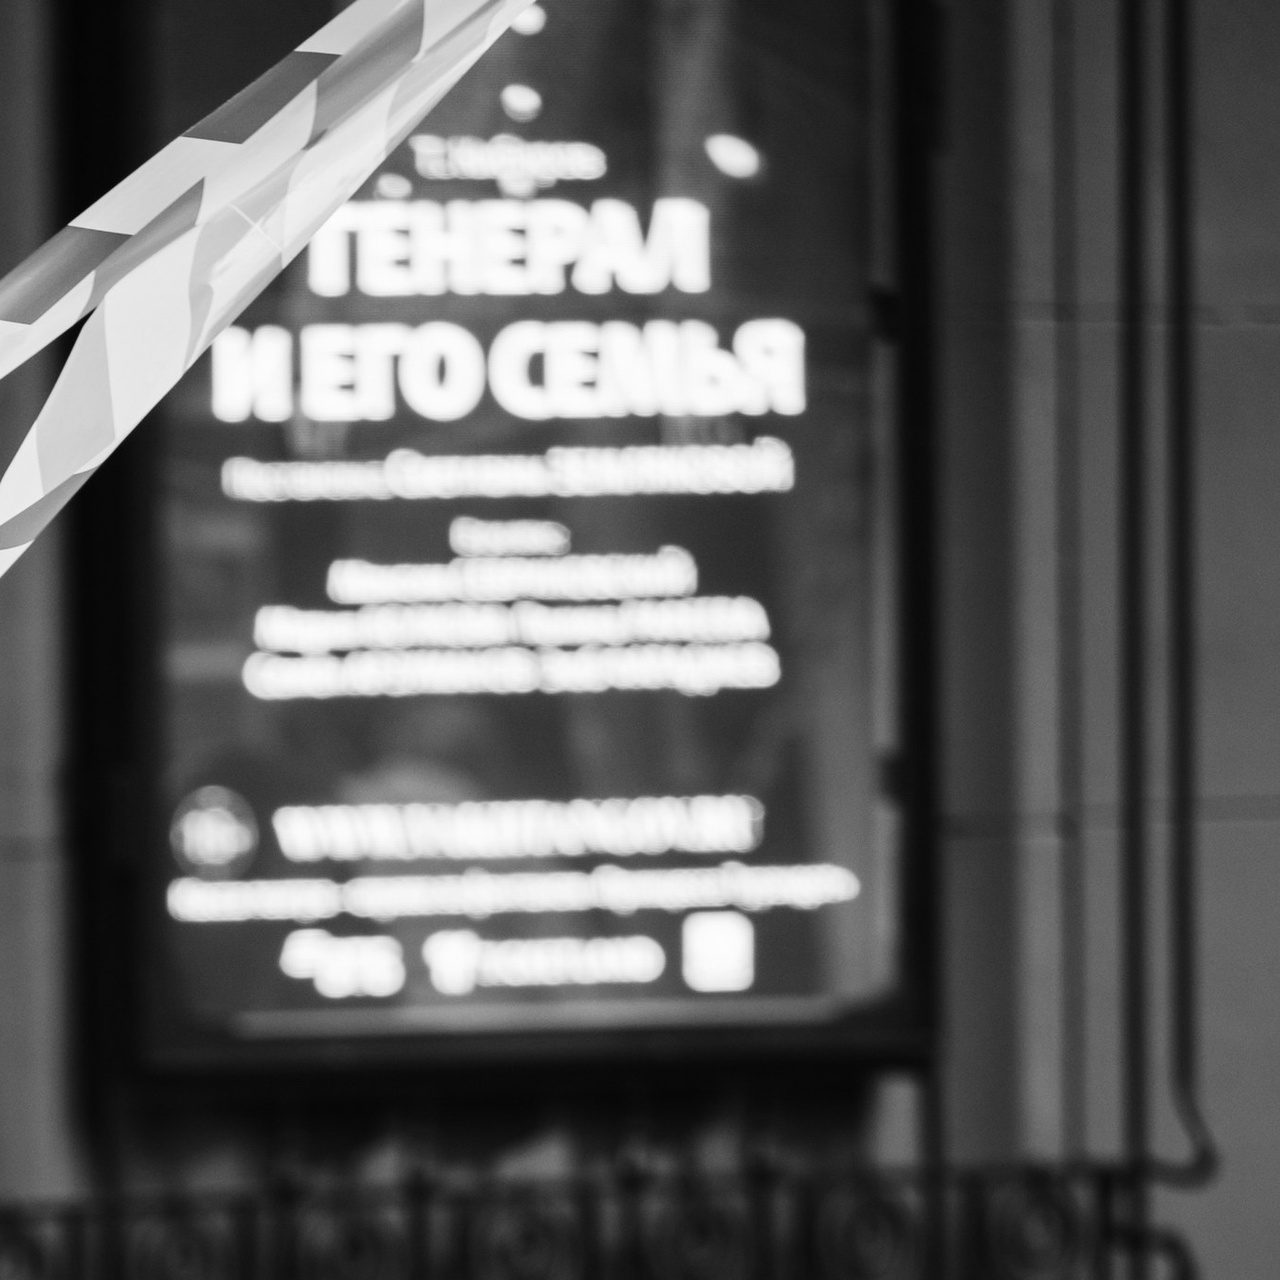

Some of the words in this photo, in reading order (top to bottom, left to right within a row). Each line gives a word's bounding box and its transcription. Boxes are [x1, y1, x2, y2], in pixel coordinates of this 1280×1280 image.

[306, 197, 711, 297] ГЕНЕРАЛ
[210, 322, 295, 422] И
[299, 320, 487, 422] ЕГО
[487, 318, 807, 420] СЕМЬЯ
